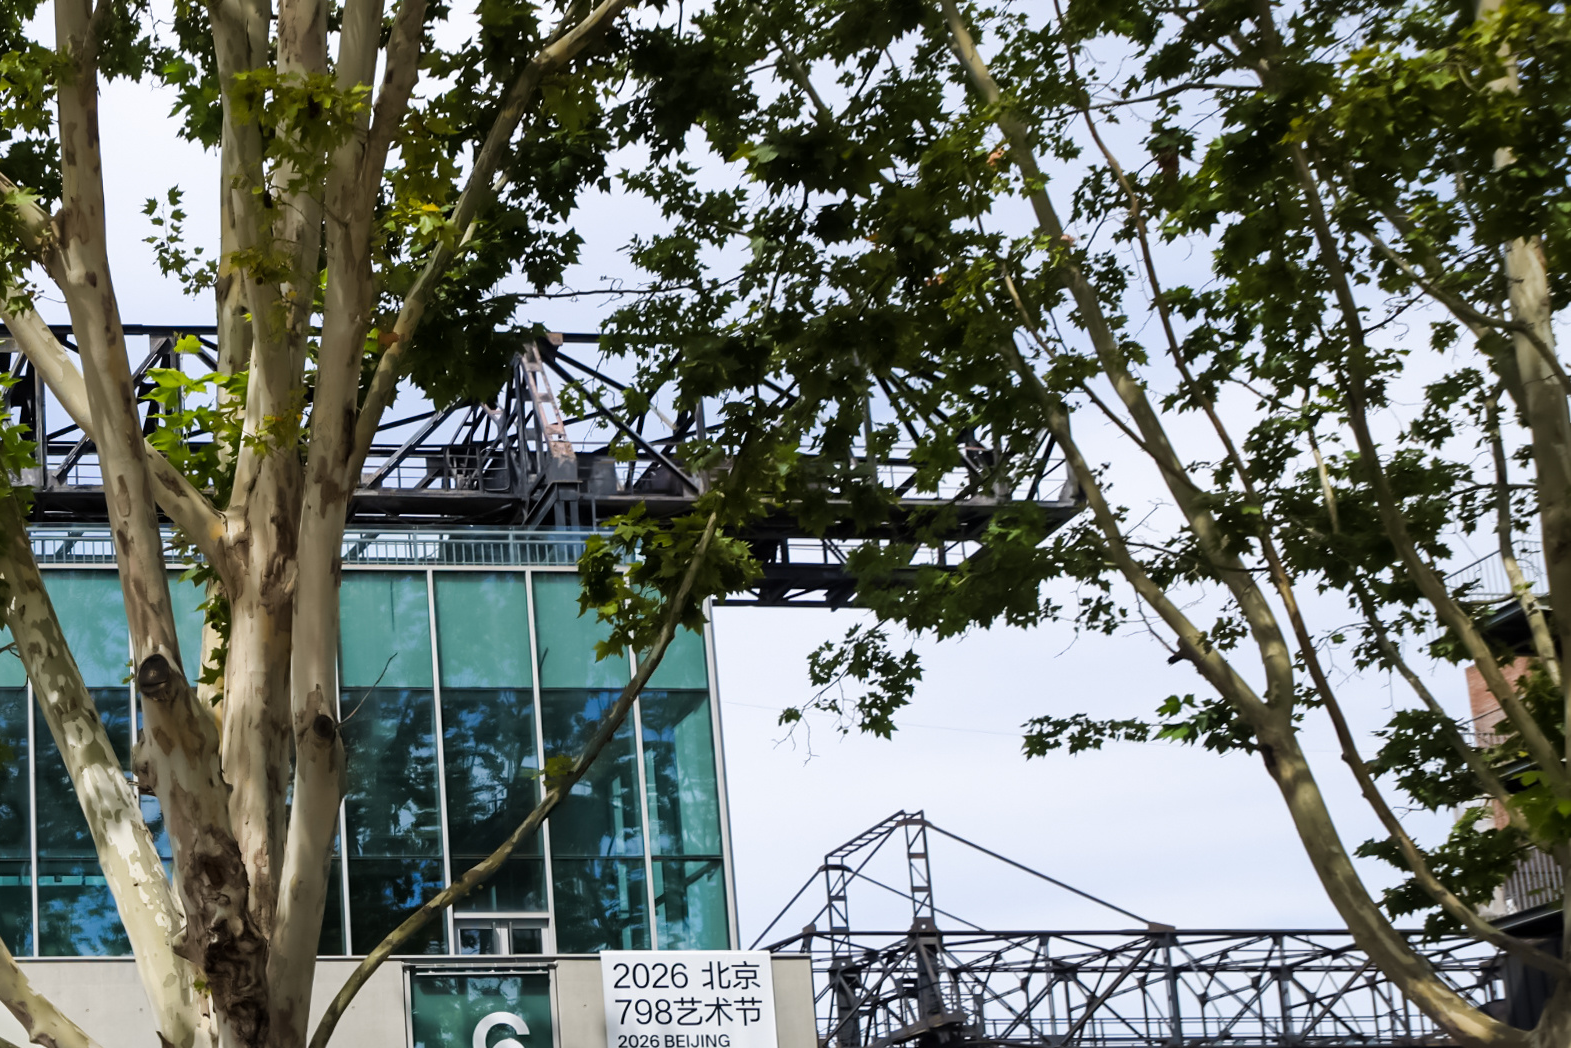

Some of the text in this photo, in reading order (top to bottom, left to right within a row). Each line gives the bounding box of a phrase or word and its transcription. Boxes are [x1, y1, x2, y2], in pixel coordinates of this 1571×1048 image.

[613, 960, 761, 991] 2026 北京
[614, 996, 763, 1028] 798艺术节
[618, 1033, 731, 1048] 2026 BEIJING
